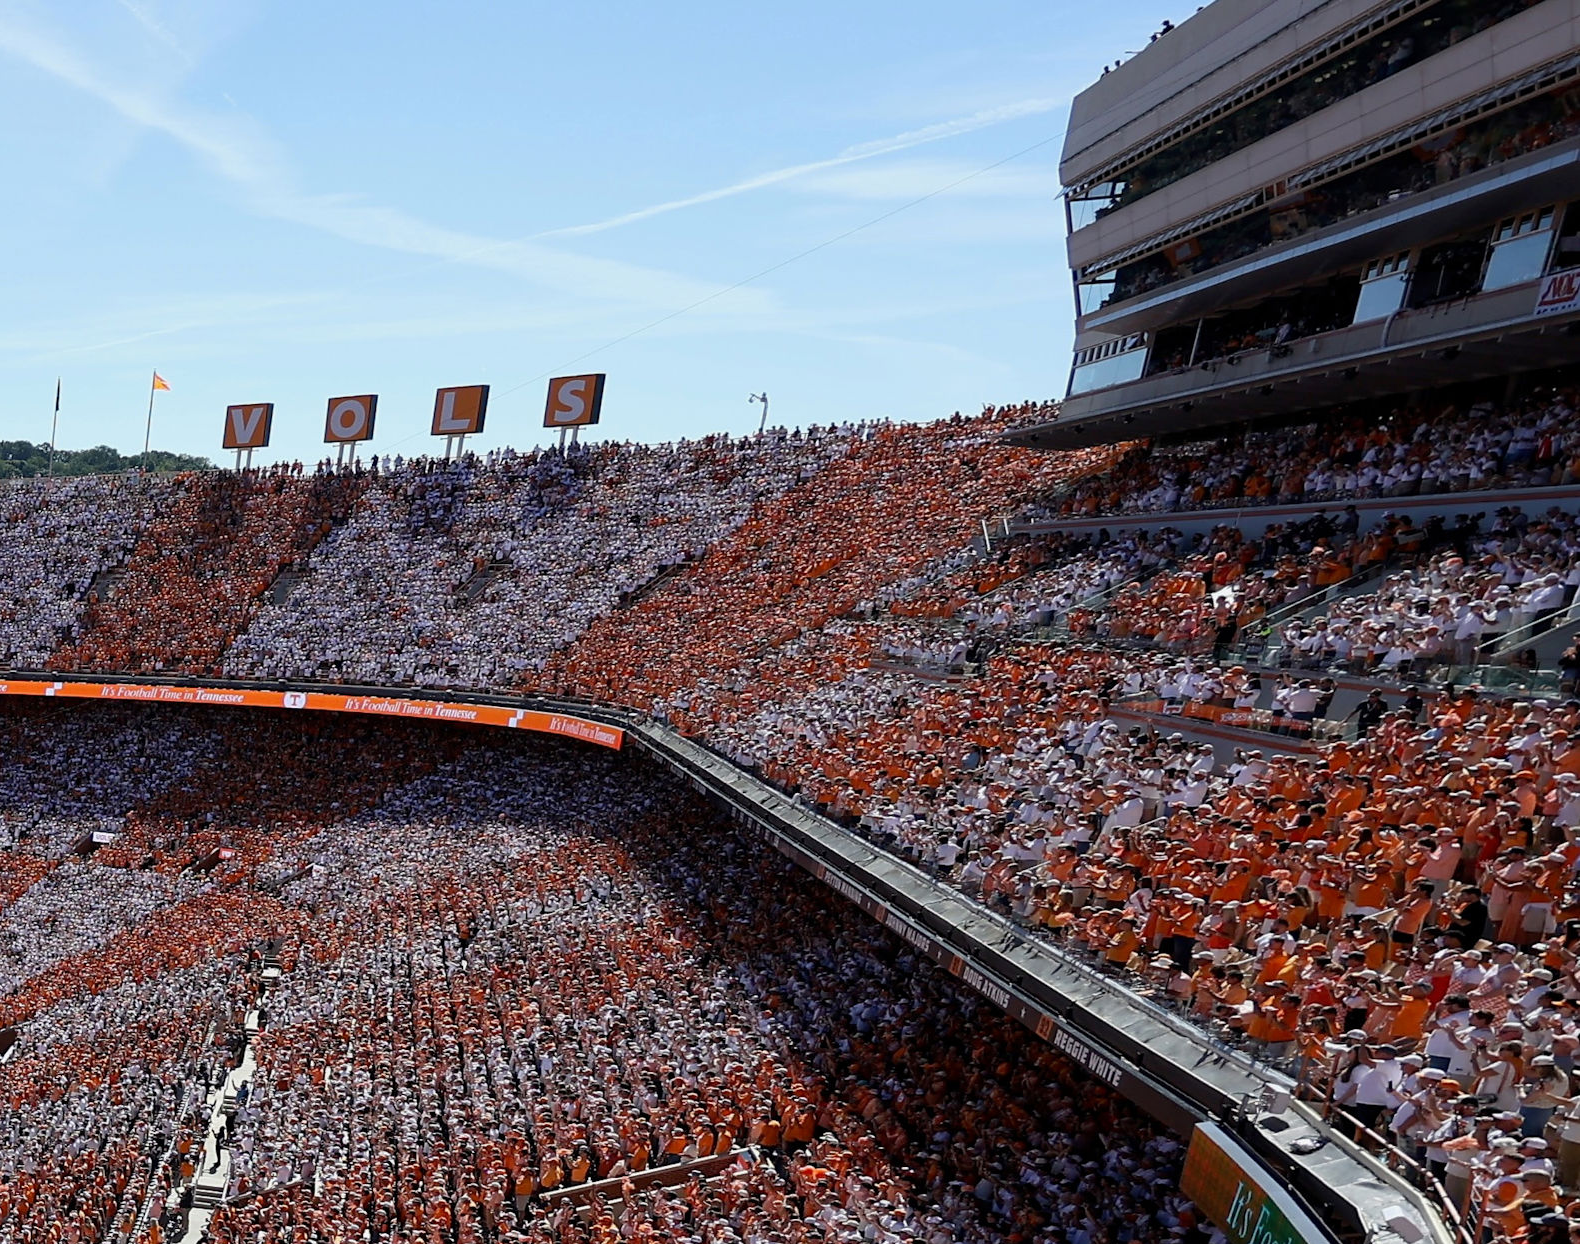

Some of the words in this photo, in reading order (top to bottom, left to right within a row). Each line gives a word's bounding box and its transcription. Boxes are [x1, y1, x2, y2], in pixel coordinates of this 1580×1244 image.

[119, 687, 157, 698] Football
[159, 688, 181, 699] Time
[184, 690, 193, 700] in
[195, 690, 243, 702] Tennessee
[290, 694, 301, 705] T
[362, 700, 400, 712] Football
[401, 702, 422, 714] Time
[425, 704, 433, 715] in
[435, 705, 477, 720] Tennessee
[963, 966, 983, 990] DOUG
[983, 978, 1010, 1009] ATKINS
[1054, 1029, 1089, 1064] REGGIE
[1089, 1053, 1123, 1087] WHITE
